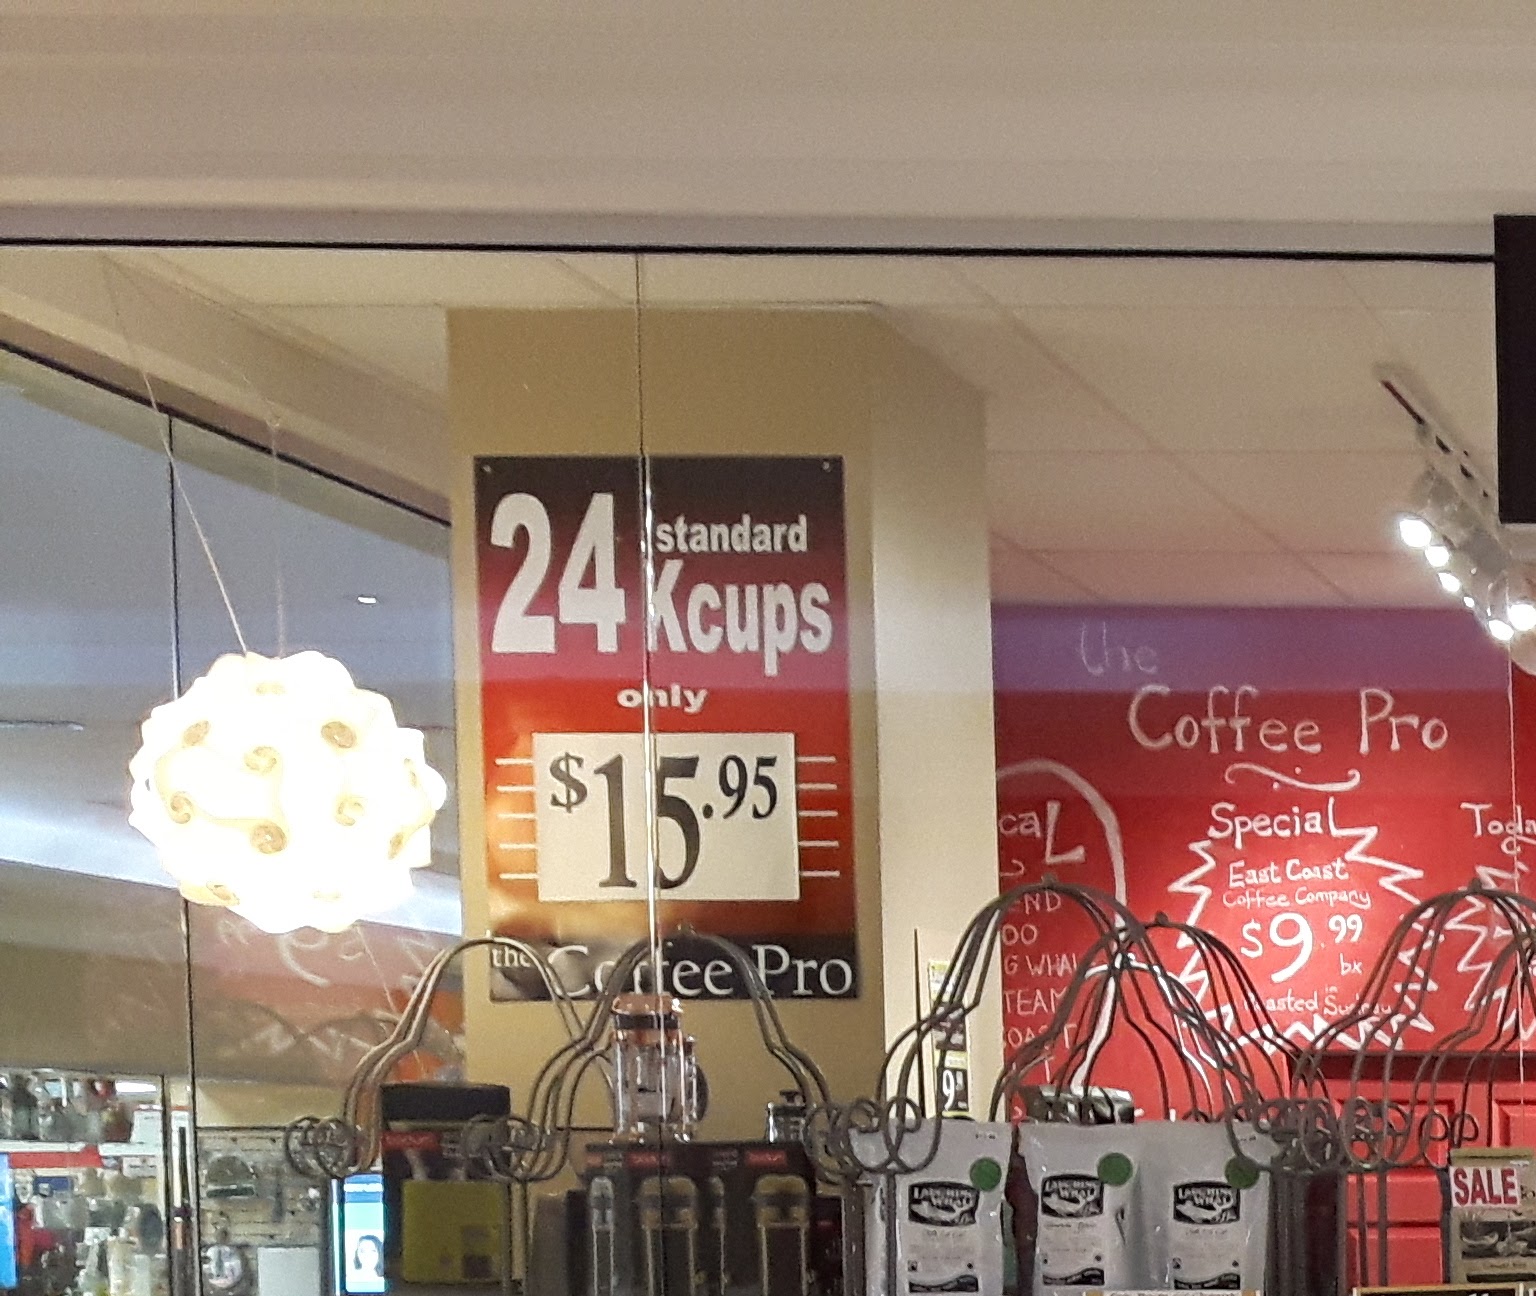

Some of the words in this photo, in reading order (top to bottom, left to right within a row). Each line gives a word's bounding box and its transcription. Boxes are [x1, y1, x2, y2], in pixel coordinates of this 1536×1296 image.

[655, 514, 809, 553] standard
[490, 492, 626, 654] 24
[647, 559, 834, 677] Kcups
[1081, 621, 1159, 675] the
[617, 685, 708, 714] only
[1129, 684, 1322, 756] Coffee
[1360, 686, 1449, 756] Pro
[1207, 797, 1345, 850] Special
[1222, 886, 1291, 908] Coffee
[1294, 887, 1372, 910] Company
[1228, 860, 1281, 889] East
[1285, 857, 1349, 882] Coast
[754, 943, 853, 996] Pro
[1453, 1167, 1517, 1206] SALE
